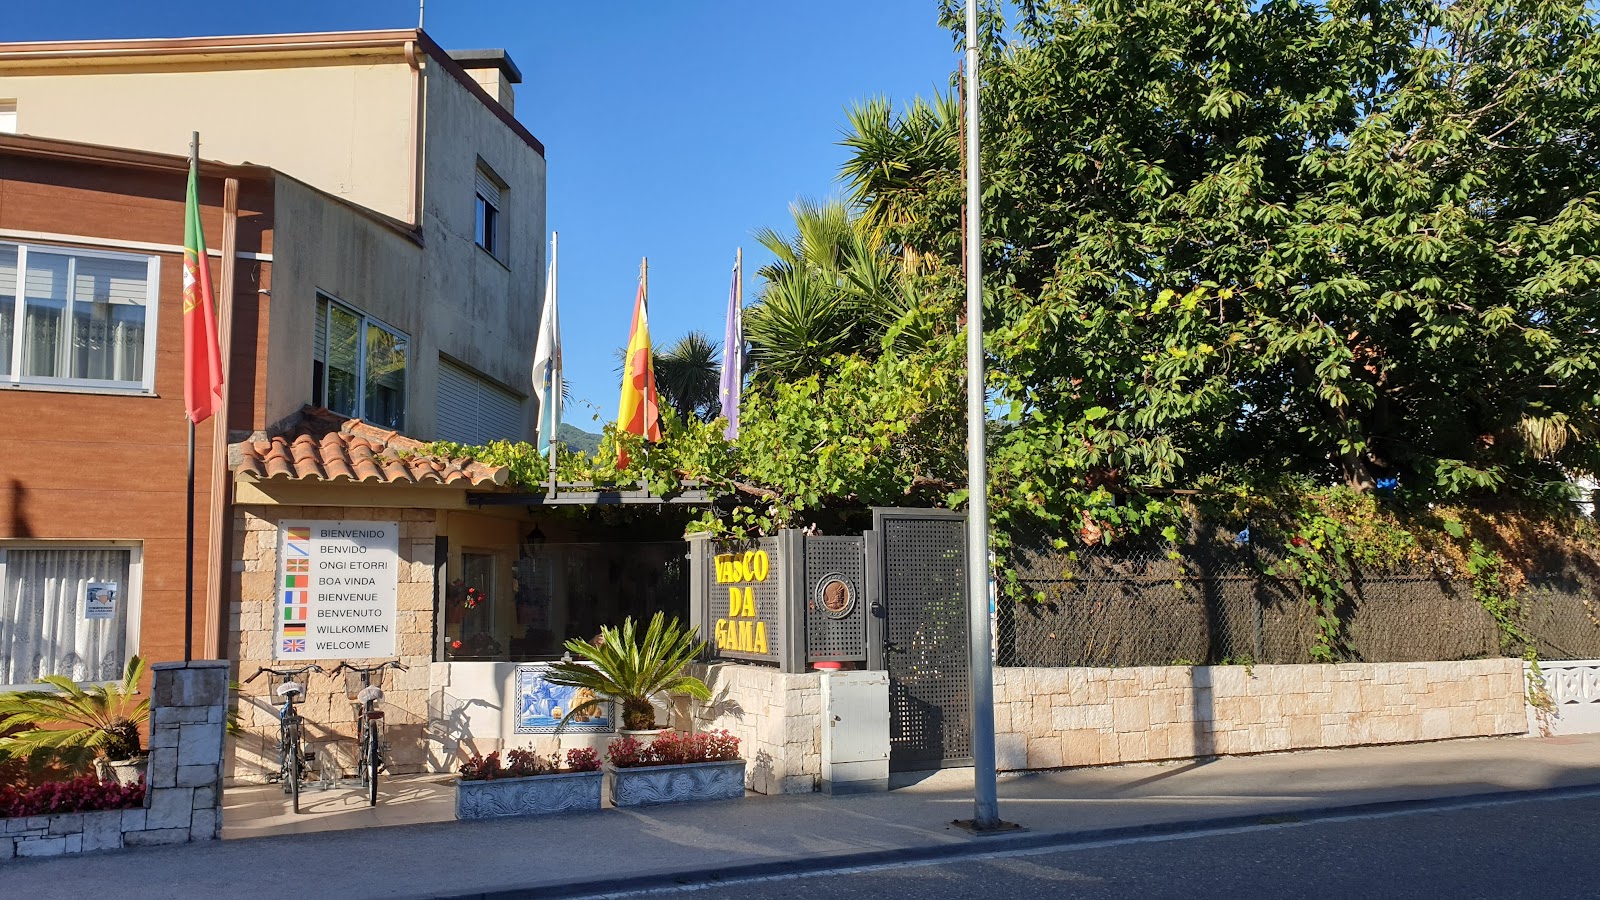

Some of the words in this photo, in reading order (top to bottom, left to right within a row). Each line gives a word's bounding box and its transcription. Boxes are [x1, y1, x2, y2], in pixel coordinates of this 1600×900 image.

[320, 529, 385, 538] BIENVENIDO
[320, 545, 367, 554] BENVIDO
[319, 561, 347, 570] ONGI
[349, 561, 388, 570] ETORRI
[714, 550, 769, 583] VASCO
[318, 577, 341, 586] BOA
[344, 577, 376, 586] VINDA
[318, 593, 378, 602] BIENVENUE
[729, 586, 756, 617] DA
[317, 608, 382, 618] BENVENUTO
[316, 625, 389, 634] WILLKOMMEN
[715, 618, 768, 654] GAMA
[316, 641, 370, 650] WELCOME
